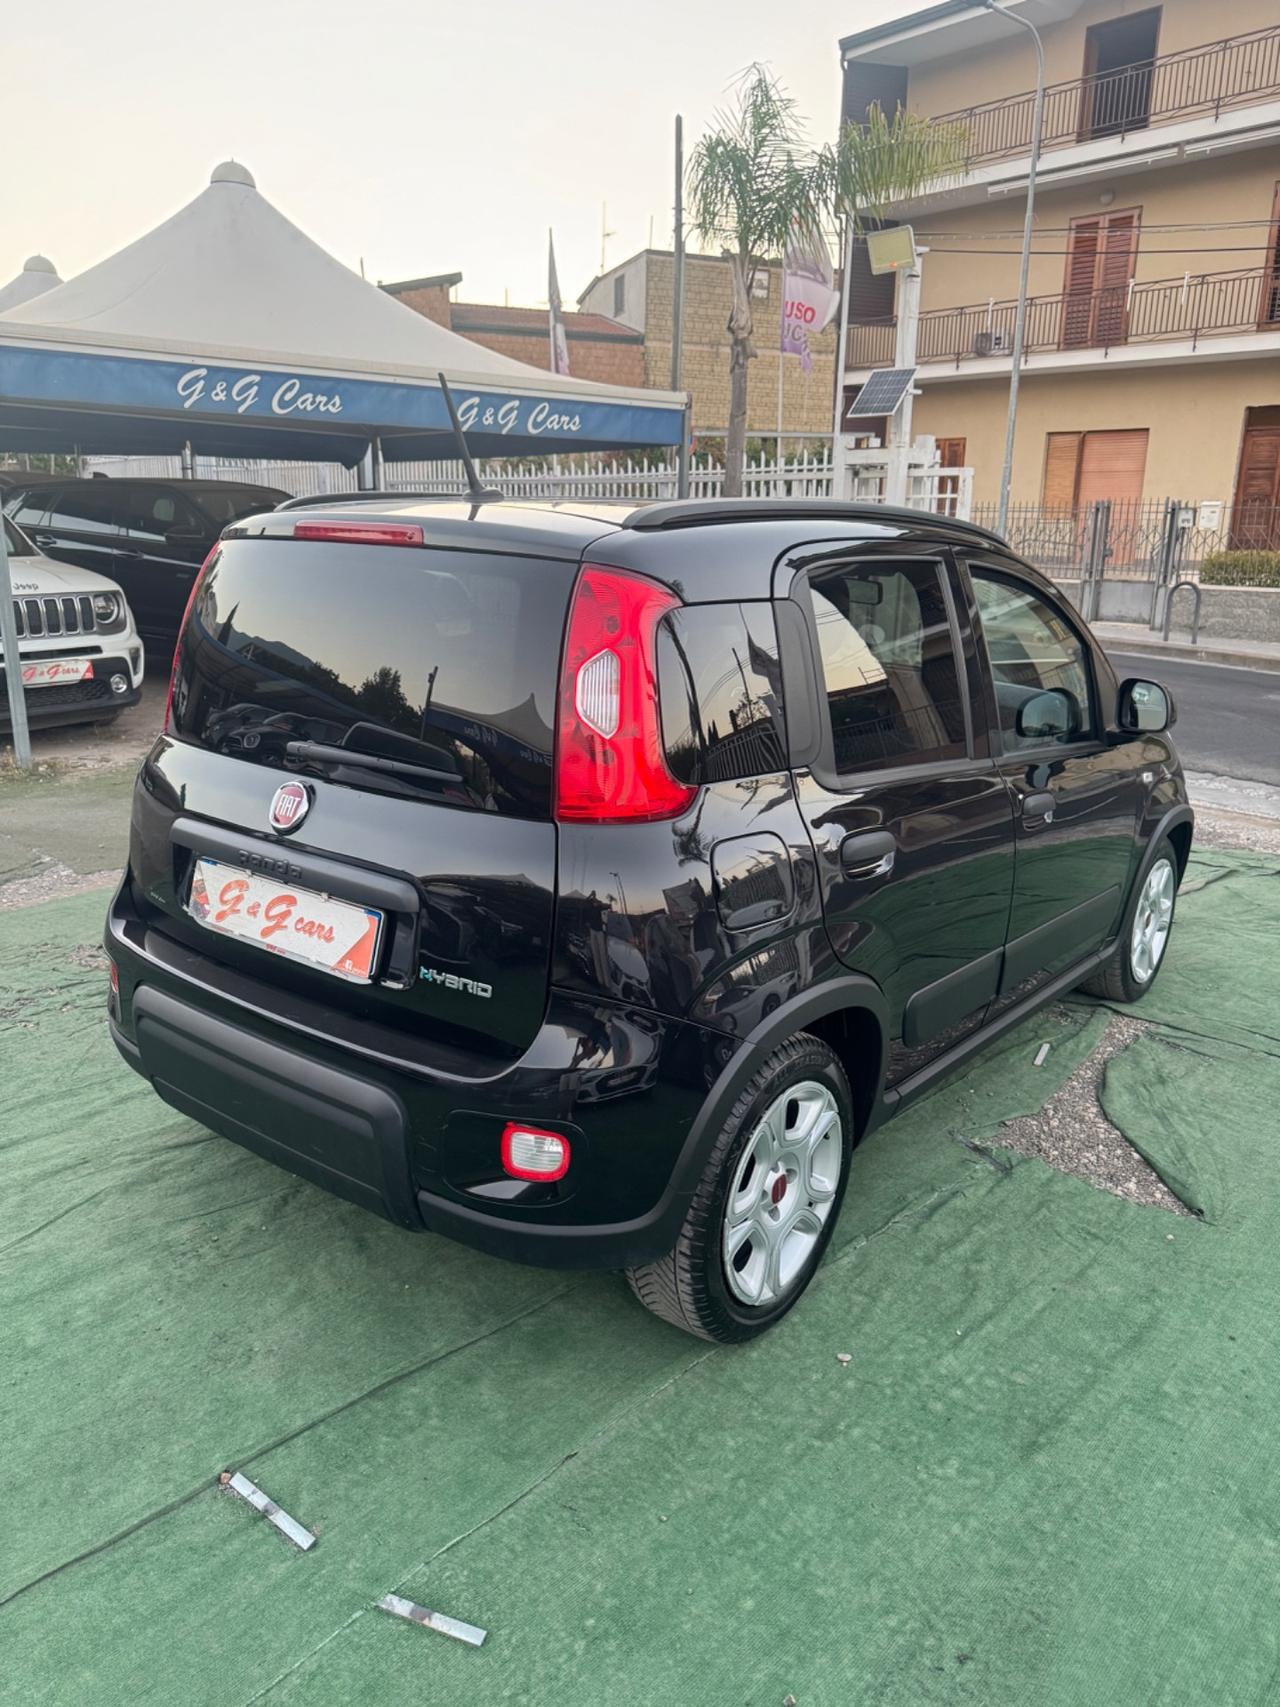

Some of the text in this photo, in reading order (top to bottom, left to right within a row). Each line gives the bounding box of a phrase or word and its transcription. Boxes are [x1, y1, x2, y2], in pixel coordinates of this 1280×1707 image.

[271, 379, 343, 415] Cars
[527, 402, 582, 435] Cars
[275, 794, 301, 817] FIAT
[294, 917, 335, 943] cars
[419, 965, 492, 998] HYBRID
